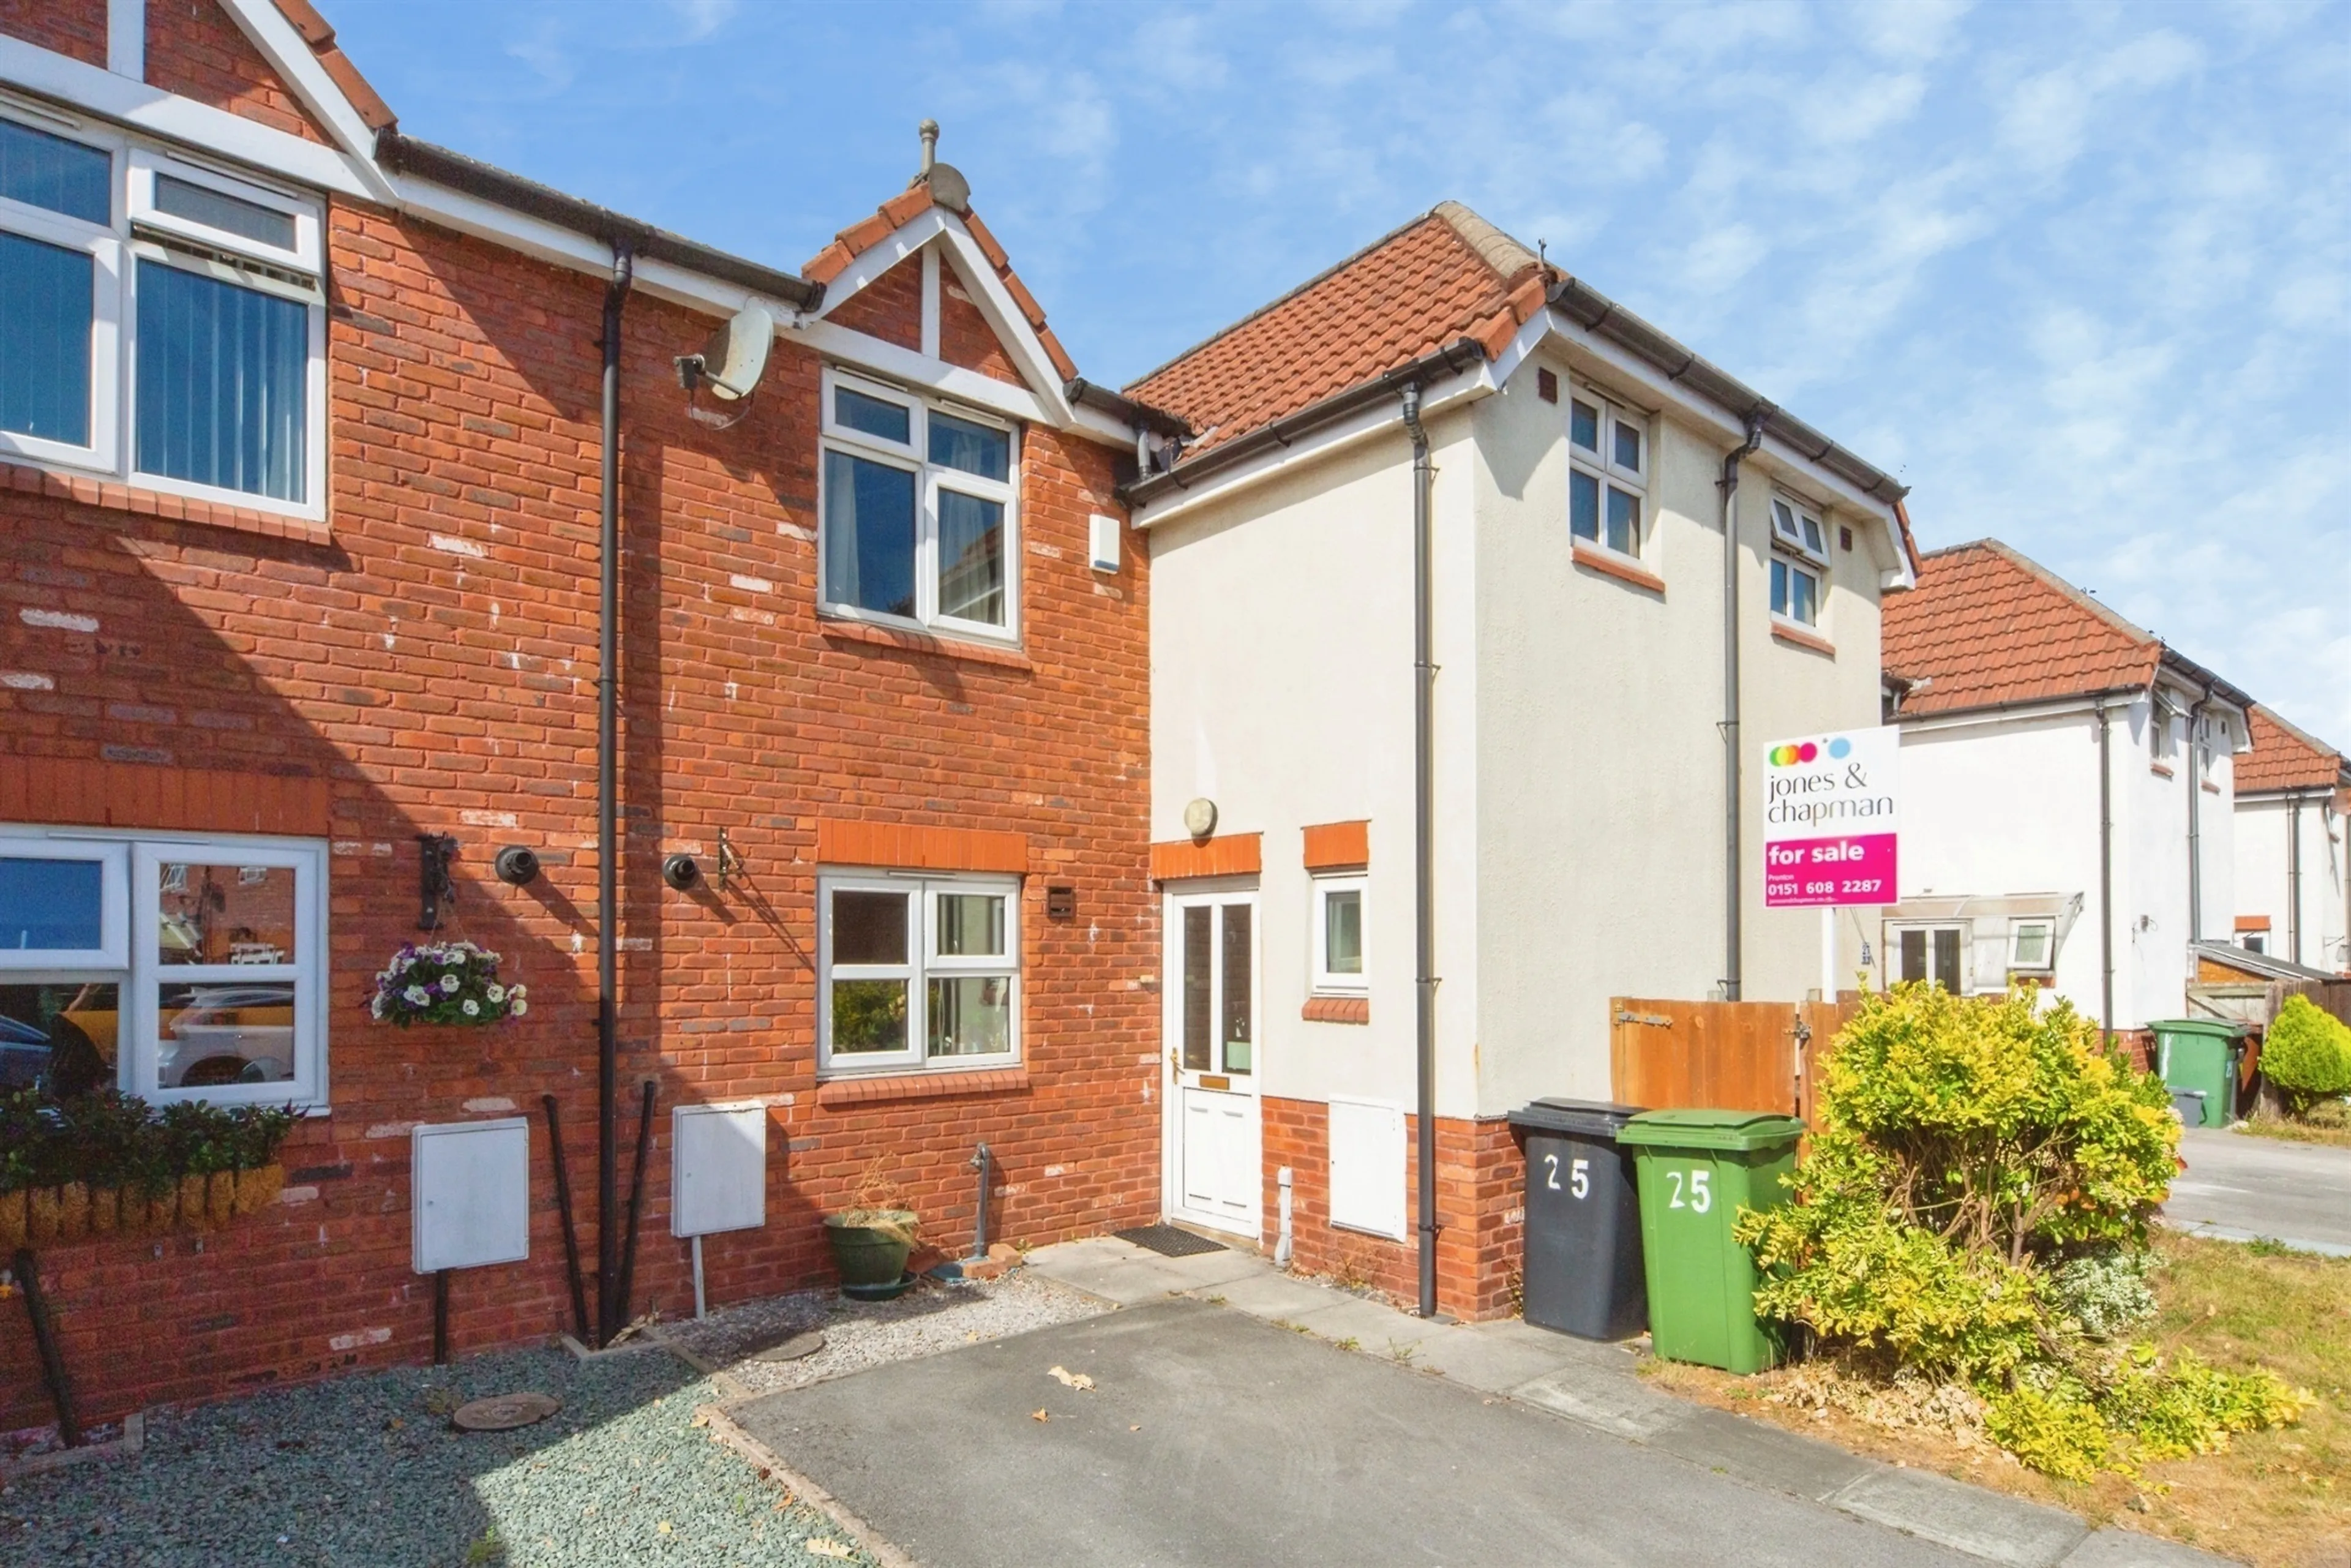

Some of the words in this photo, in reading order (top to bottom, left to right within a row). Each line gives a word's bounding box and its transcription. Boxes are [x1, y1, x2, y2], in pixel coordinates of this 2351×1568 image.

[1769, 773, 1835, 803] jones
[1845, 762, 1867, 789] &
[1768, 797, 1893, 827] chapman
[1768, 846, 1805, 865] for
[1811, 841, 1864, 862] sale
[1768, 883, 1798, 896] 0151
[1805, 882, 1834, 894] 608
[1842, 880, 1881, 893] 2287
[1666, 1170, 1712, 1214] 25
